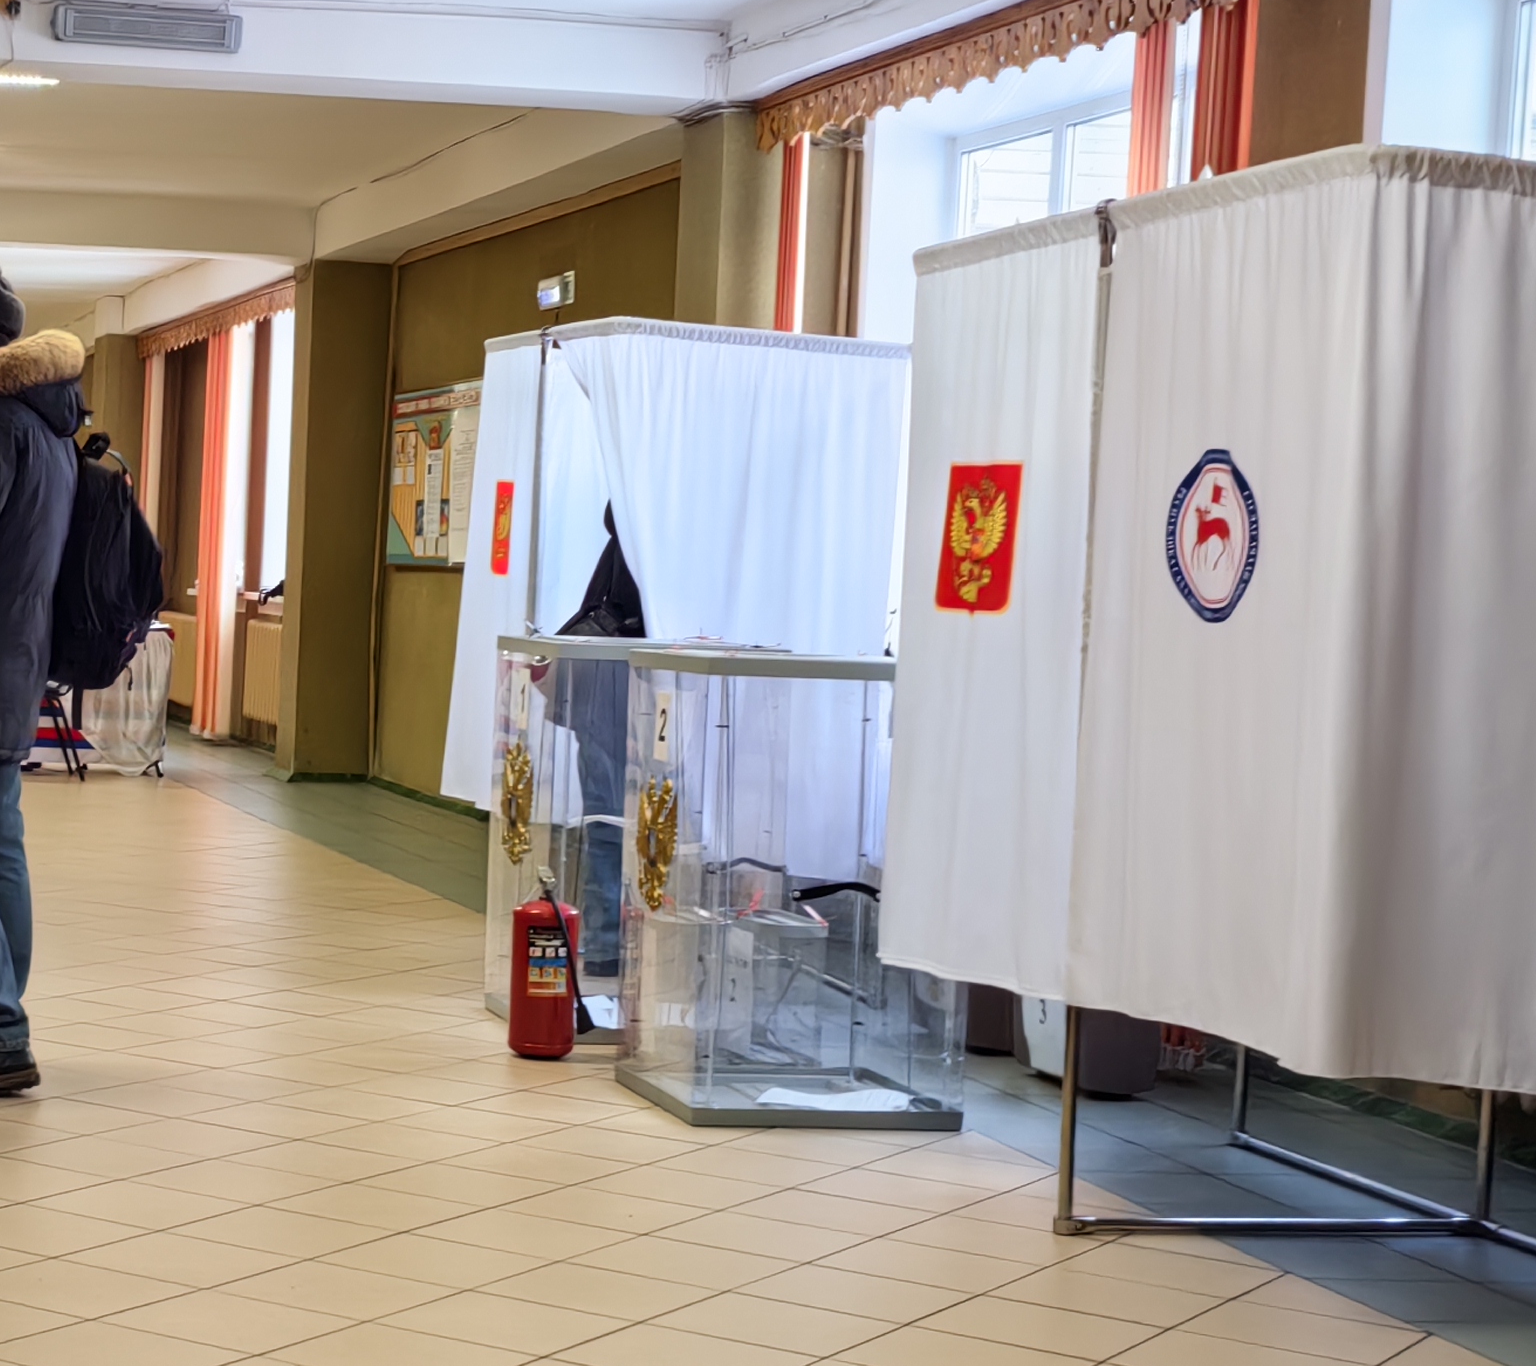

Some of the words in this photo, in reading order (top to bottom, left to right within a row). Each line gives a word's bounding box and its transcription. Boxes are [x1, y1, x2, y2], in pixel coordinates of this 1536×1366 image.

[520, 683, 526, 714] 1
[658, 708, 667, 742] 2
[1039, 999, 1047, 1024] 3
